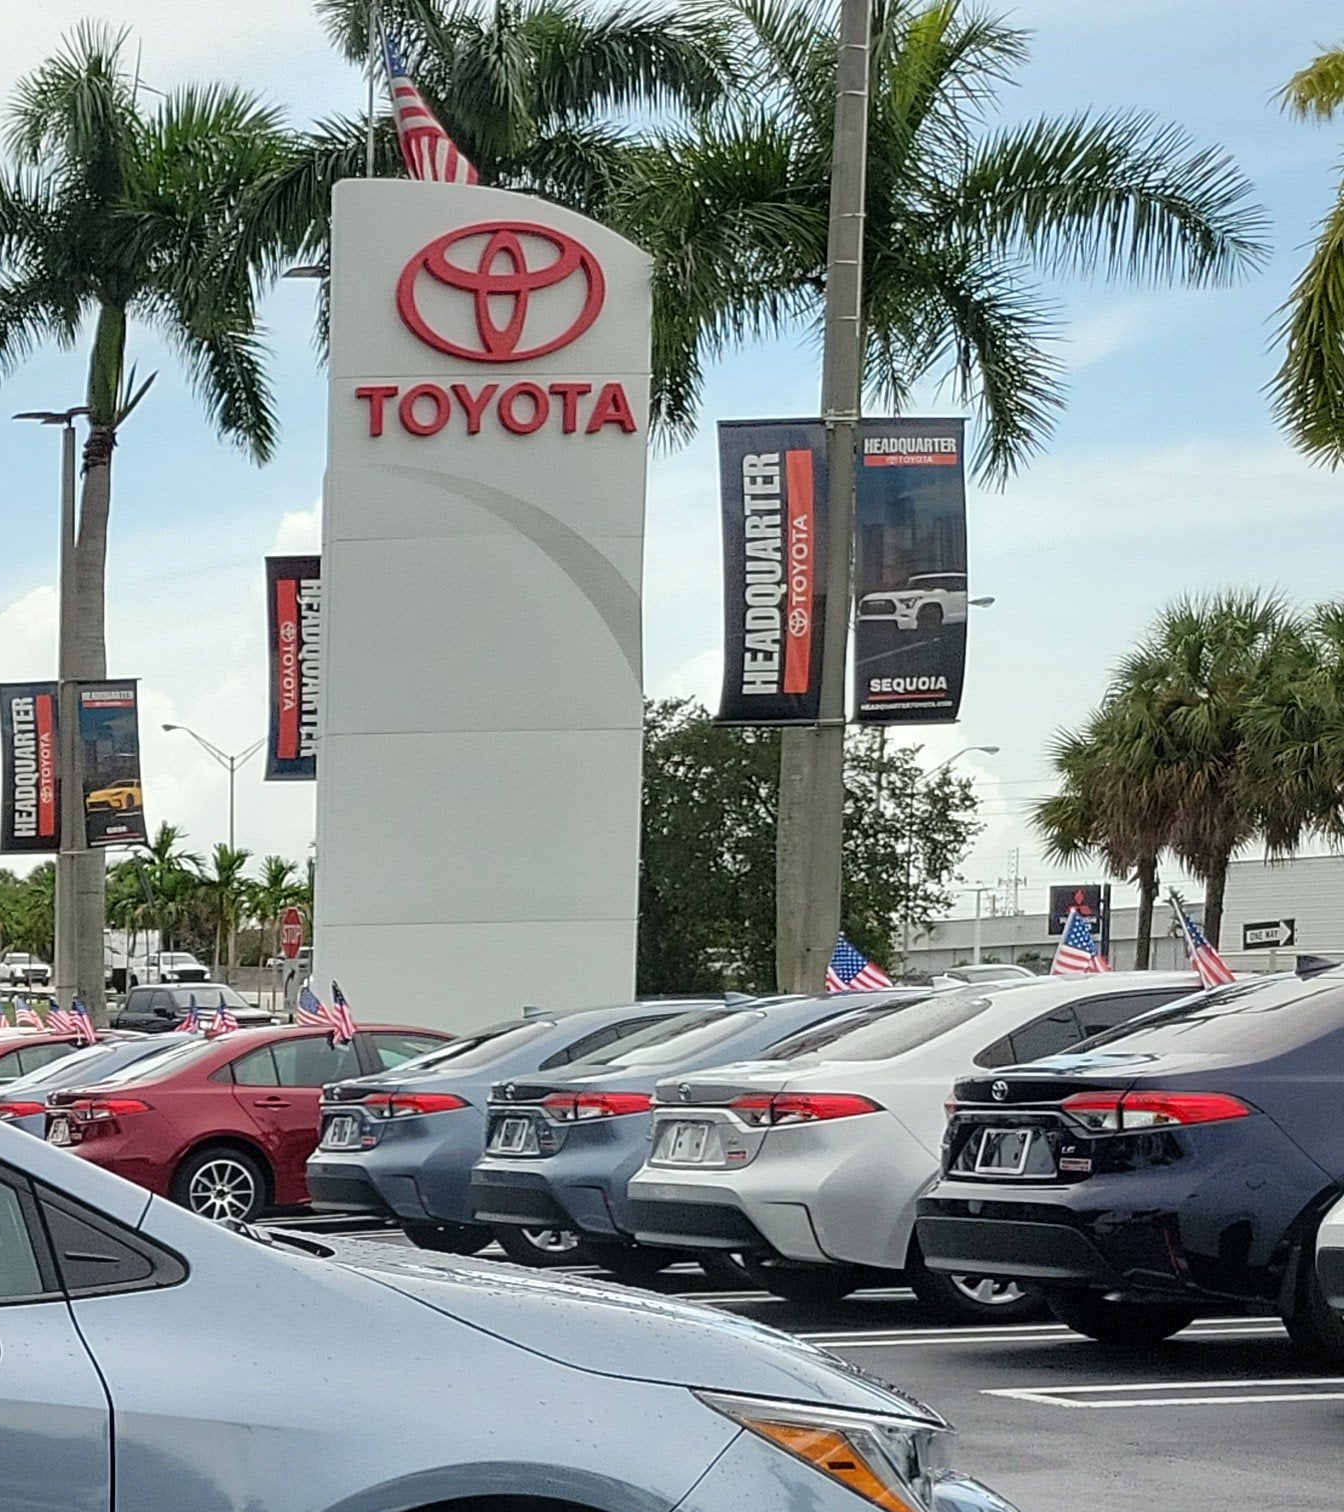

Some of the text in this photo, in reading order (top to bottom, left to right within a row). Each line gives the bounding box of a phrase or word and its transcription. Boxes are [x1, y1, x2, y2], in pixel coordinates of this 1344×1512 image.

[355, 382, 637, 437] TOYOTA
[864, 438, 957, 454] HEADQUARTER
[742, 452, 787, 695] HEADQUARTER
[792, 513, 809, 606] TOYOTA
[282, 643, 294, 711] TOYOTA
[870, 676, 947, 693] SEQUOIA
[12, 697, 40, 837] HEADQUARTER
[41, 732, 53, 785] TOYOTA
[283, 924, 301, 944] STOP
[1249, 931, 1264, 942] ONE
